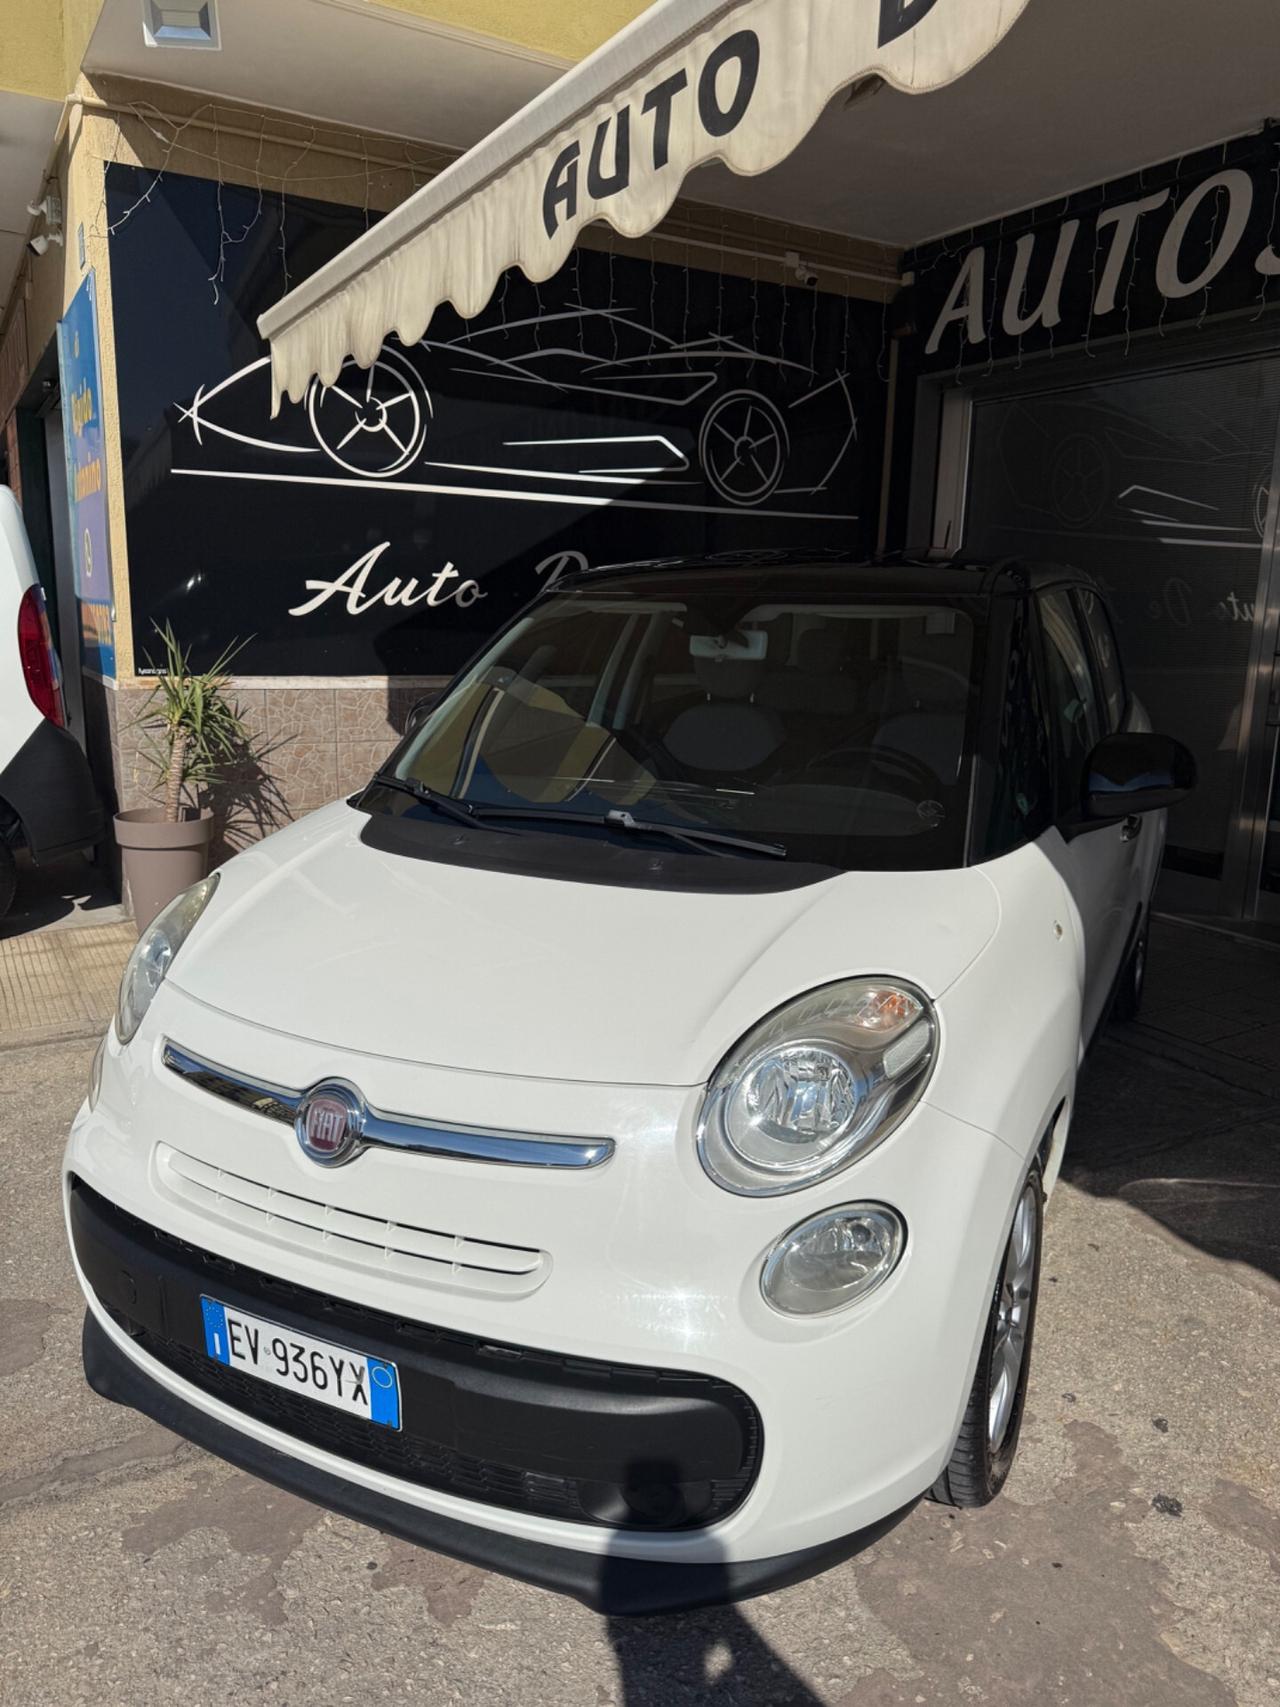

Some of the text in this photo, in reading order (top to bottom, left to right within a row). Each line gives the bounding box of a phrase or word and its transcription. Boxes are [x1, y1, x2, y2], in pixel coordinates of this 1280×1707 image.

[541, 29, 760, 239] AUTO
[925, 168, 1280, 354] AUTO
[288, 541, 487, 617] Auto
[311, 1108, 343, 1142] FIAT
